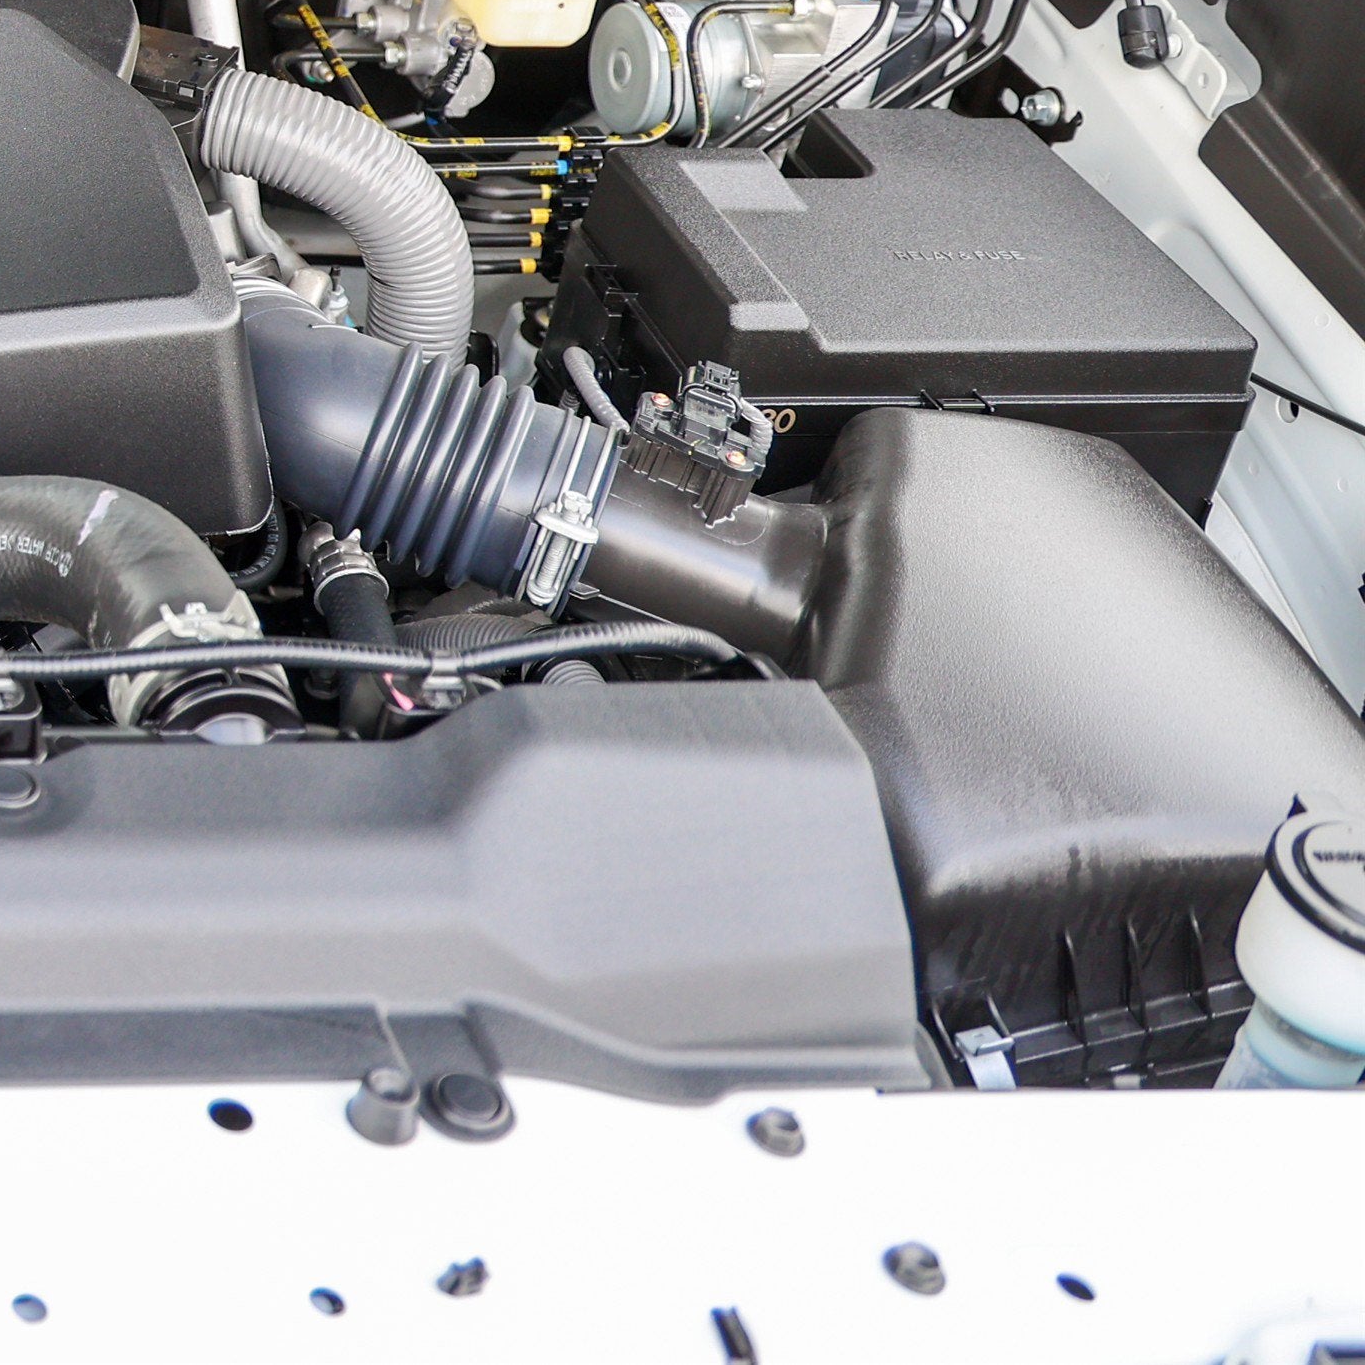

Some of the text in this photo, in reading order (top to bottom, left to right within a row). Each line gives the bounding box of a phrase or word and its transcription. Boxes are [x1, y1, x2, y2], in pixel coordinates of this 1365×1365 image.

[893, 250, 1027, 261] RELAY & FUSE
